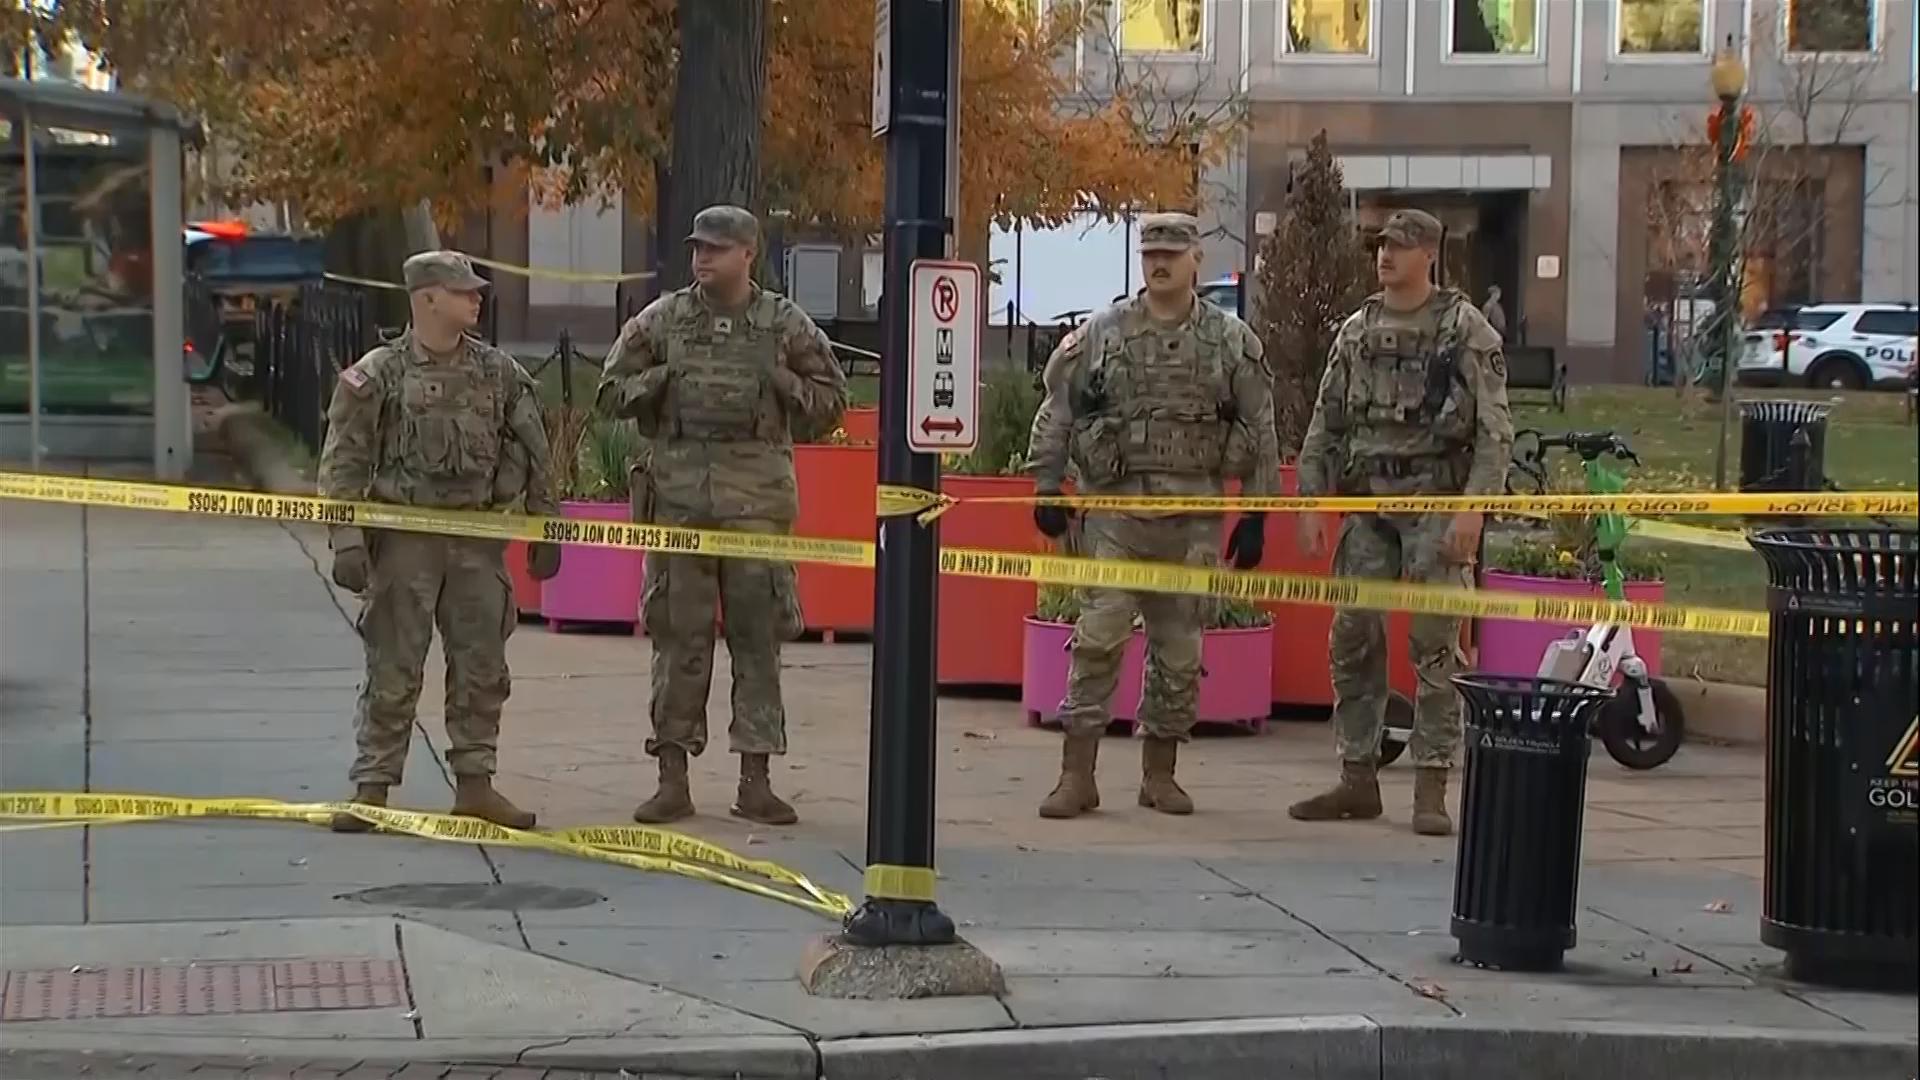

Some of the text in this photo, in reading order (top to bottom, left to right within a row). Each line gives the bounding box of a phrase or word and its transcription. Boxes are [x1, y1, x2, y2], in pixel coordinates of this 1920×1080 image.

[188, 492, 355, 522] CRIME SCENE DO NOT CROSS
[543, 520, 580, 541] CROSS
[583, 524, 604, 543] NOT
[608, 525, 623, 544] DO
[626, 526, 661, 550] SCENE
[664, 530, 700, 550] CRIME
[941, 552, 956, 571] DO
[959, 553, 993, 575] SCENE
[997, 557, 1032, 577] CRIME
